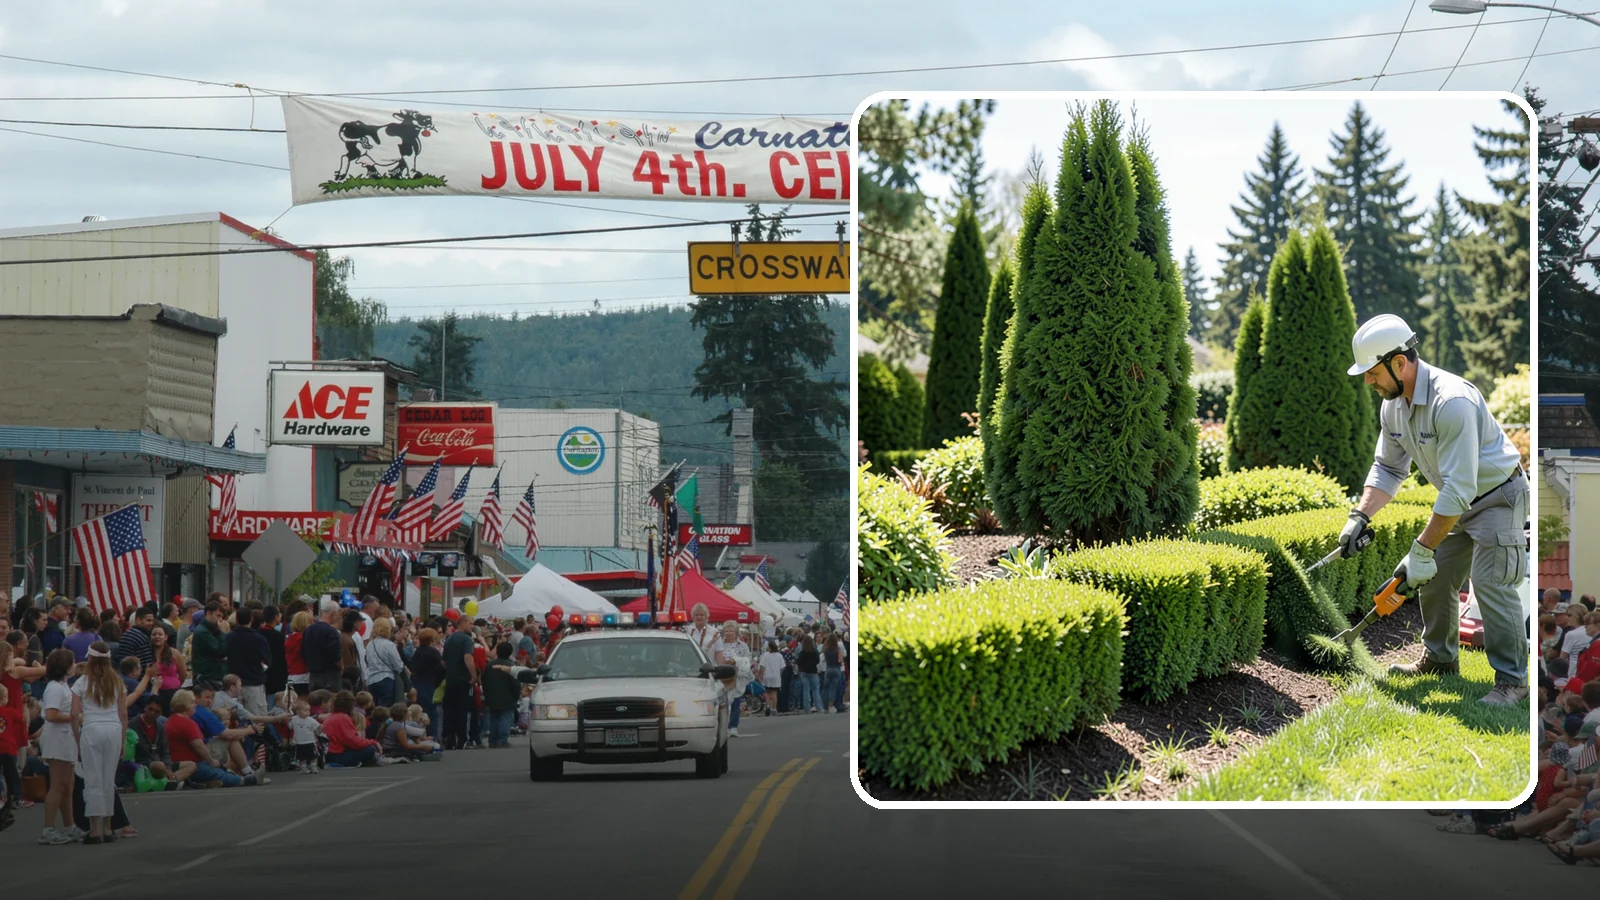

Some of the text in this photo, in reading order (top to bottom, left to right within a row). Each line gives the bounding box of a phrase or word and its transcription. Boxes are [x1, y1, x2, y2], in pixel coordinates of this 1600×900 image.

[481, 141, 604, 192] JULY
[632, 150, 746, 197] 4th.
[697, 254, 850, 279] CROSSWA
[283, 380, 373, 420] ACE
[406, 409, 452, 422] CEDAR
[284, 421, 370, 436] Hardware
[416, 428, 477, 446] Coca-Cola
[353, 467, 387, 480] Simpl
[83, 485, 155, 495] St. Vincent de Paul
[688, 526, 741, 535] CRNATION
[699, 535, 730, 543] GLASS
